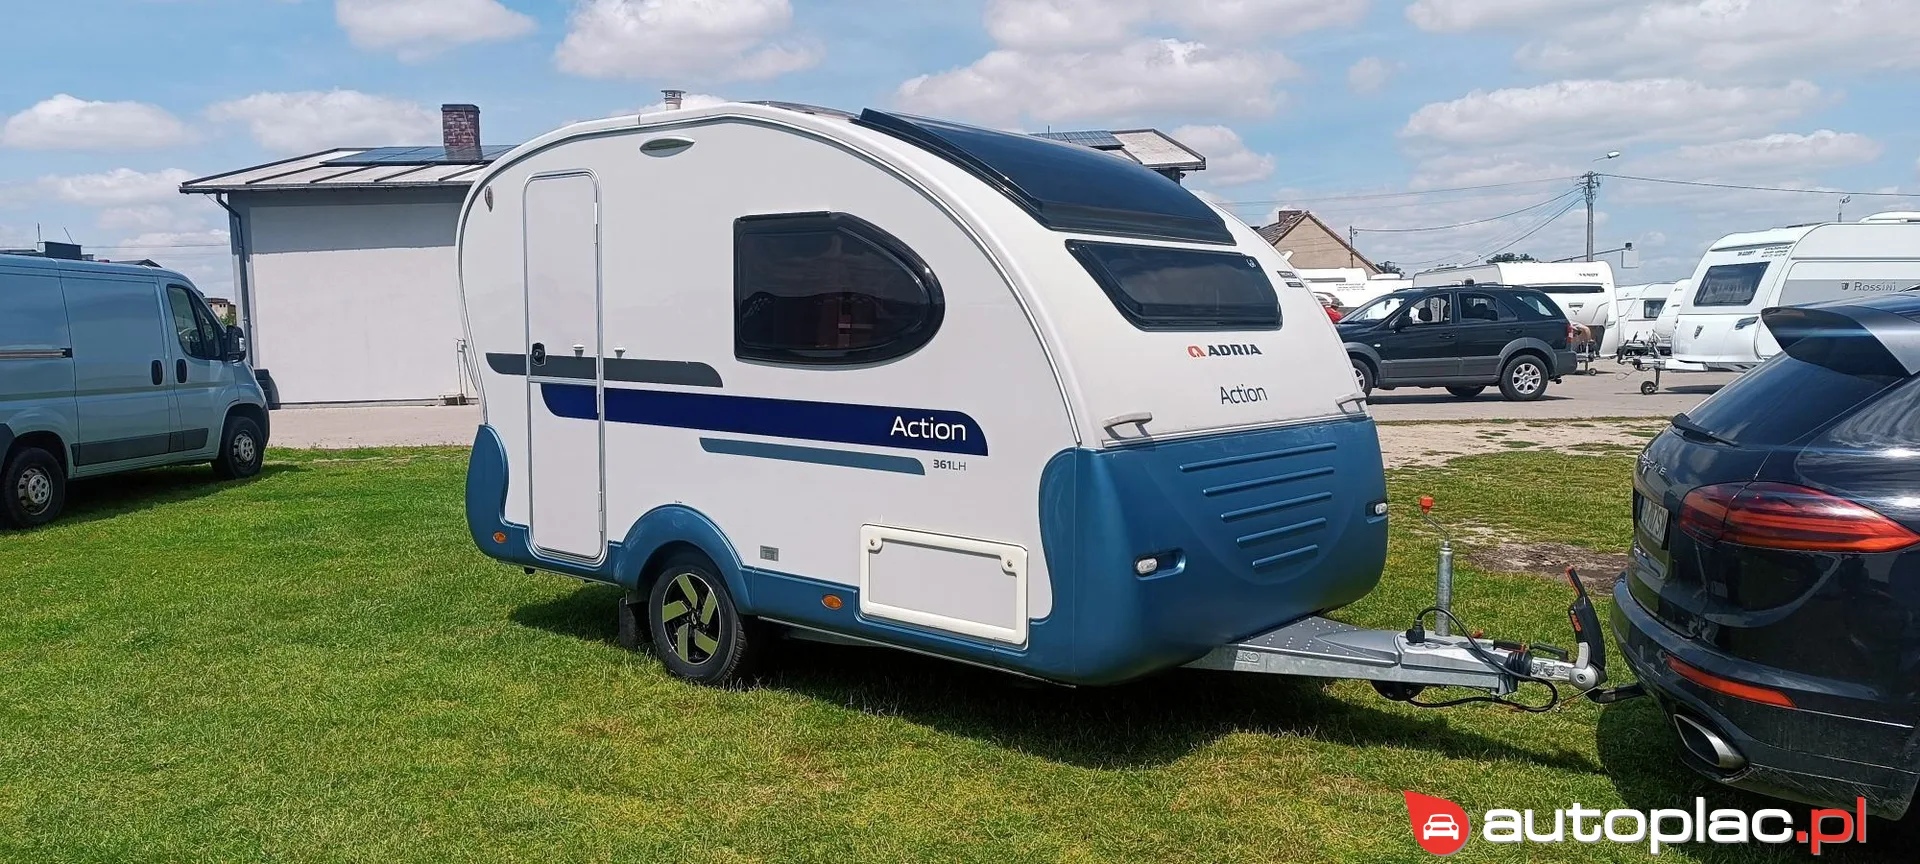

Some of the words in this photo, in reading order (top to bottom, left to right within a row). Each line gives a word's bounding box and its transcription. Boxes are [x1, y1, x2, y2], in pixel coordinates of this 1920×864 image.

[1854, 280, 1896, 292] Rossini
[1207, 344, 1263, 357] ADRIA
[1220, 383, 1268, 405] Action
[890, 415, 967, 441] Action
[933, 459, 967, 471] 361LH
